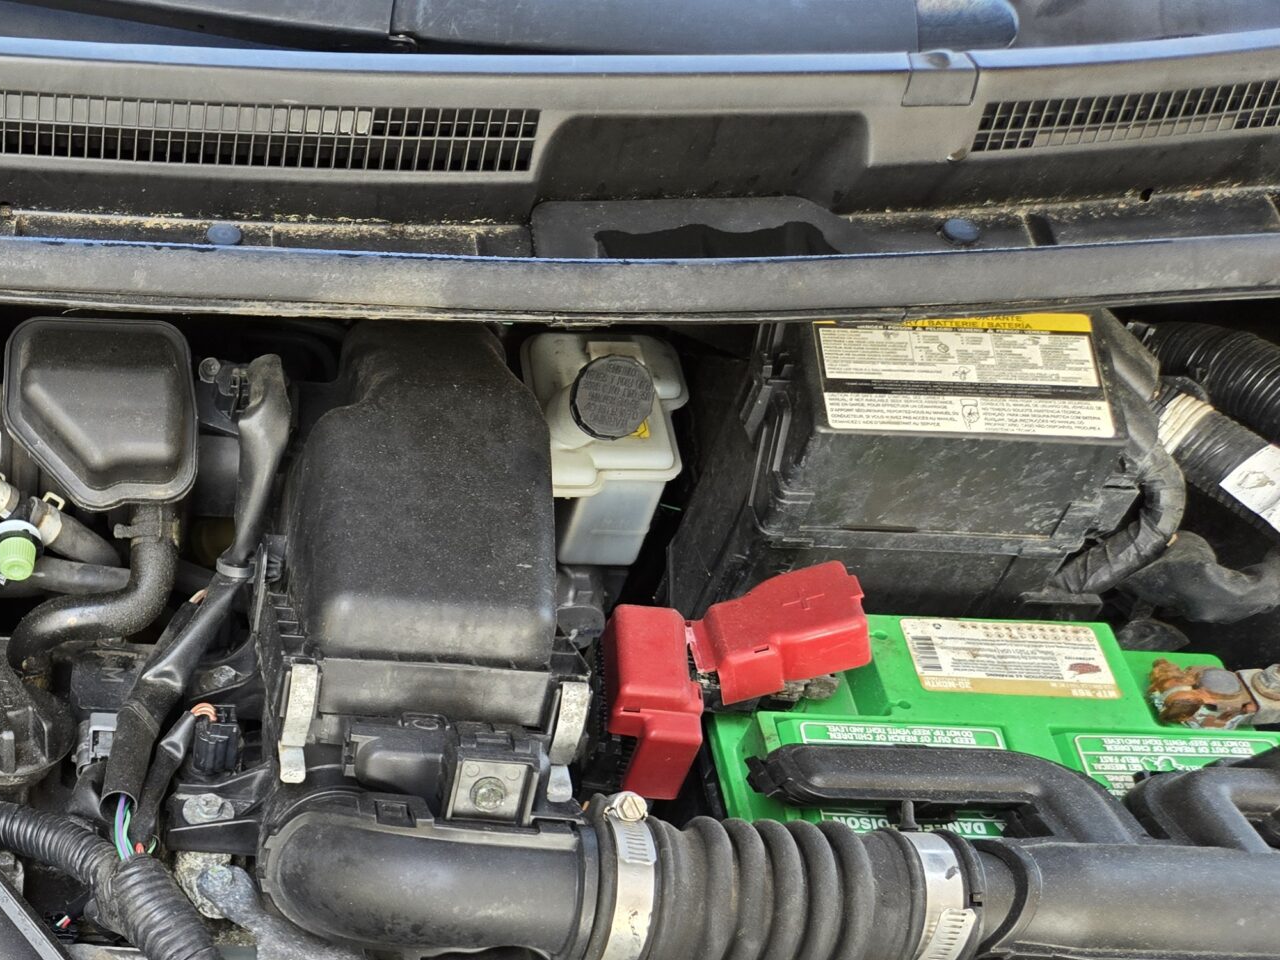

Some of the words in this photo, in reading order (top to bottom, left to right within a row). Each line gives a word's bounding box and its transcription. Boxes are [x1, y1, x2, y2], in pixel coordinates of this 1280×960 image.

[887, 727, 910, 735] VENTS
[876, 733, 886, 741] OF
[888, 734, 918, 743] REACH
[920, 735, 931, 743] OF
[933, 736, 951, 744] OUT
[953, 737, 976, 745] KEEP
[1165, 745, 1196, 753] REACH
[1198, 746, 1210, 754] OF
[1211, 746, 1230, 754] OUT
[1128, 763, 1143, 771] GET
